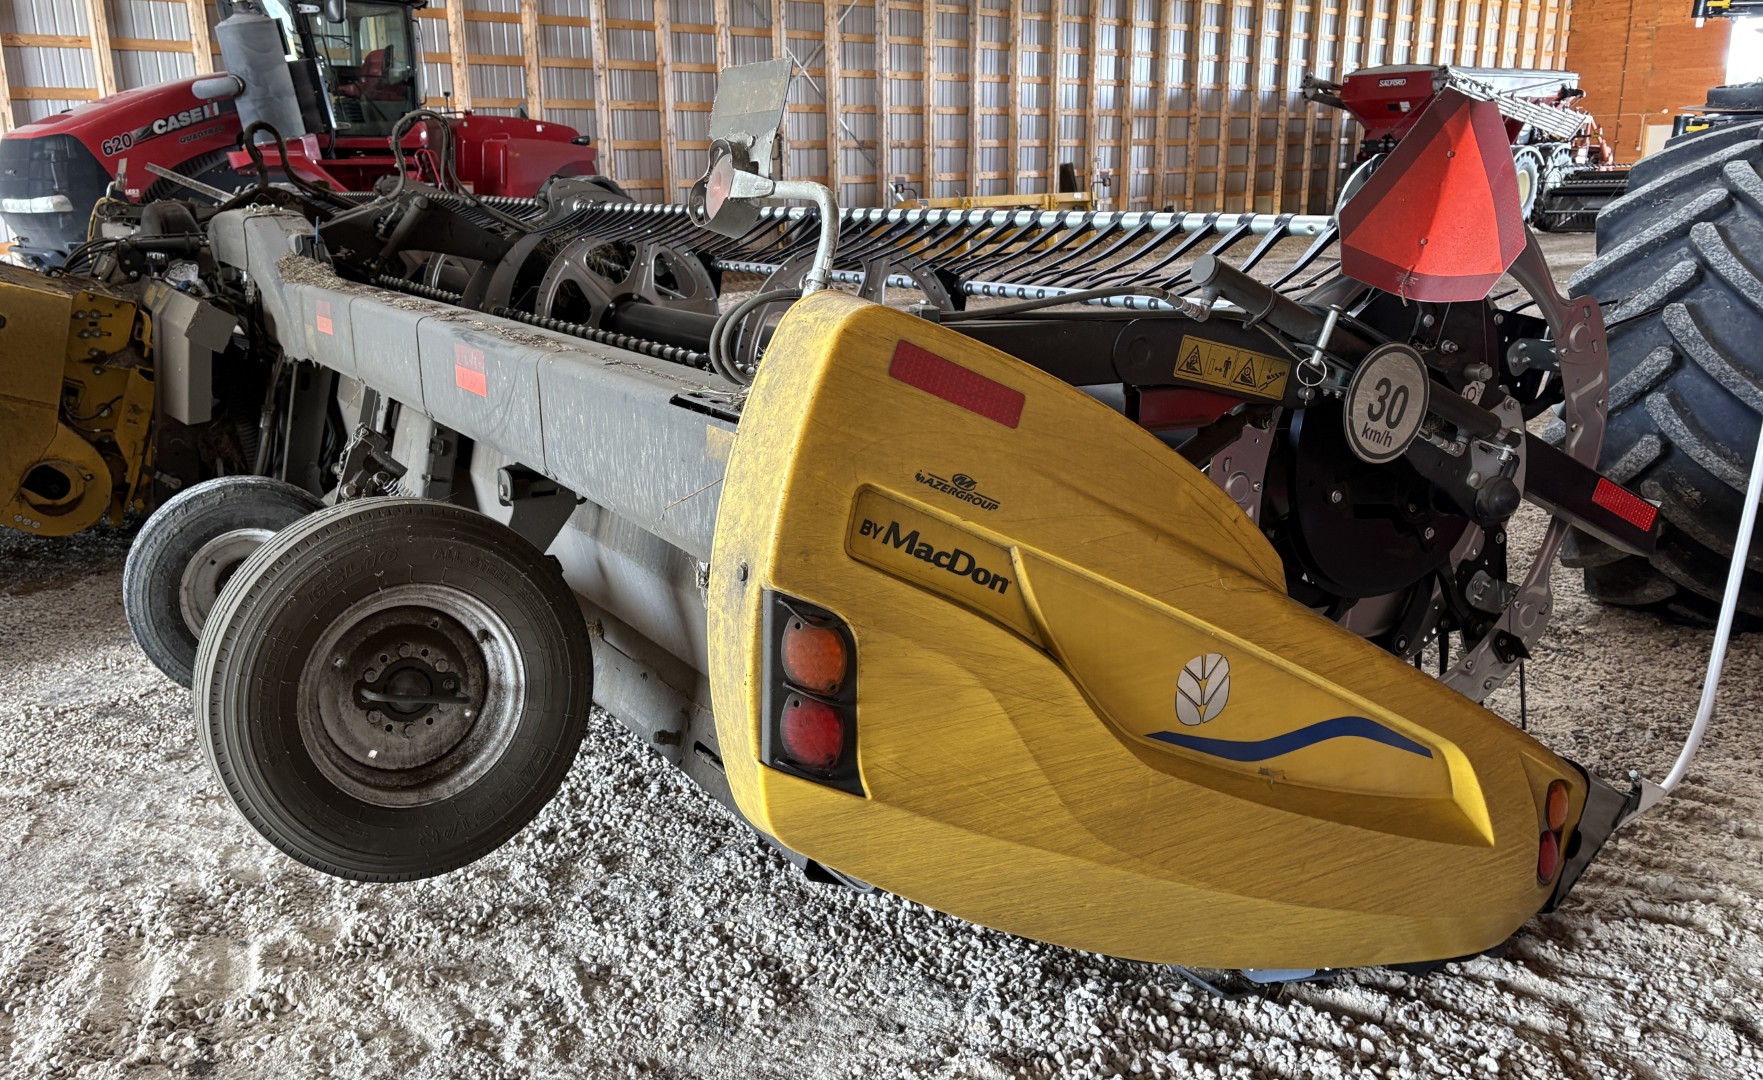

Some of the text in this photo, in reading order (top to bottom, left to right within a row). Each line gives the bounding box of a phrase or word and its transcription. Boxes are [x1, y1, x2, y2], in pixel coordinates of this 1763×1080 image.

[1379, 78, 1407, 87] SALFORD
[102, 131, 134, 157] 620
[1367, 377, 1410, 429] 30
[1361, 422, 1393, 448] km/h
[859, 518, 1010, 594] BY MacDon
